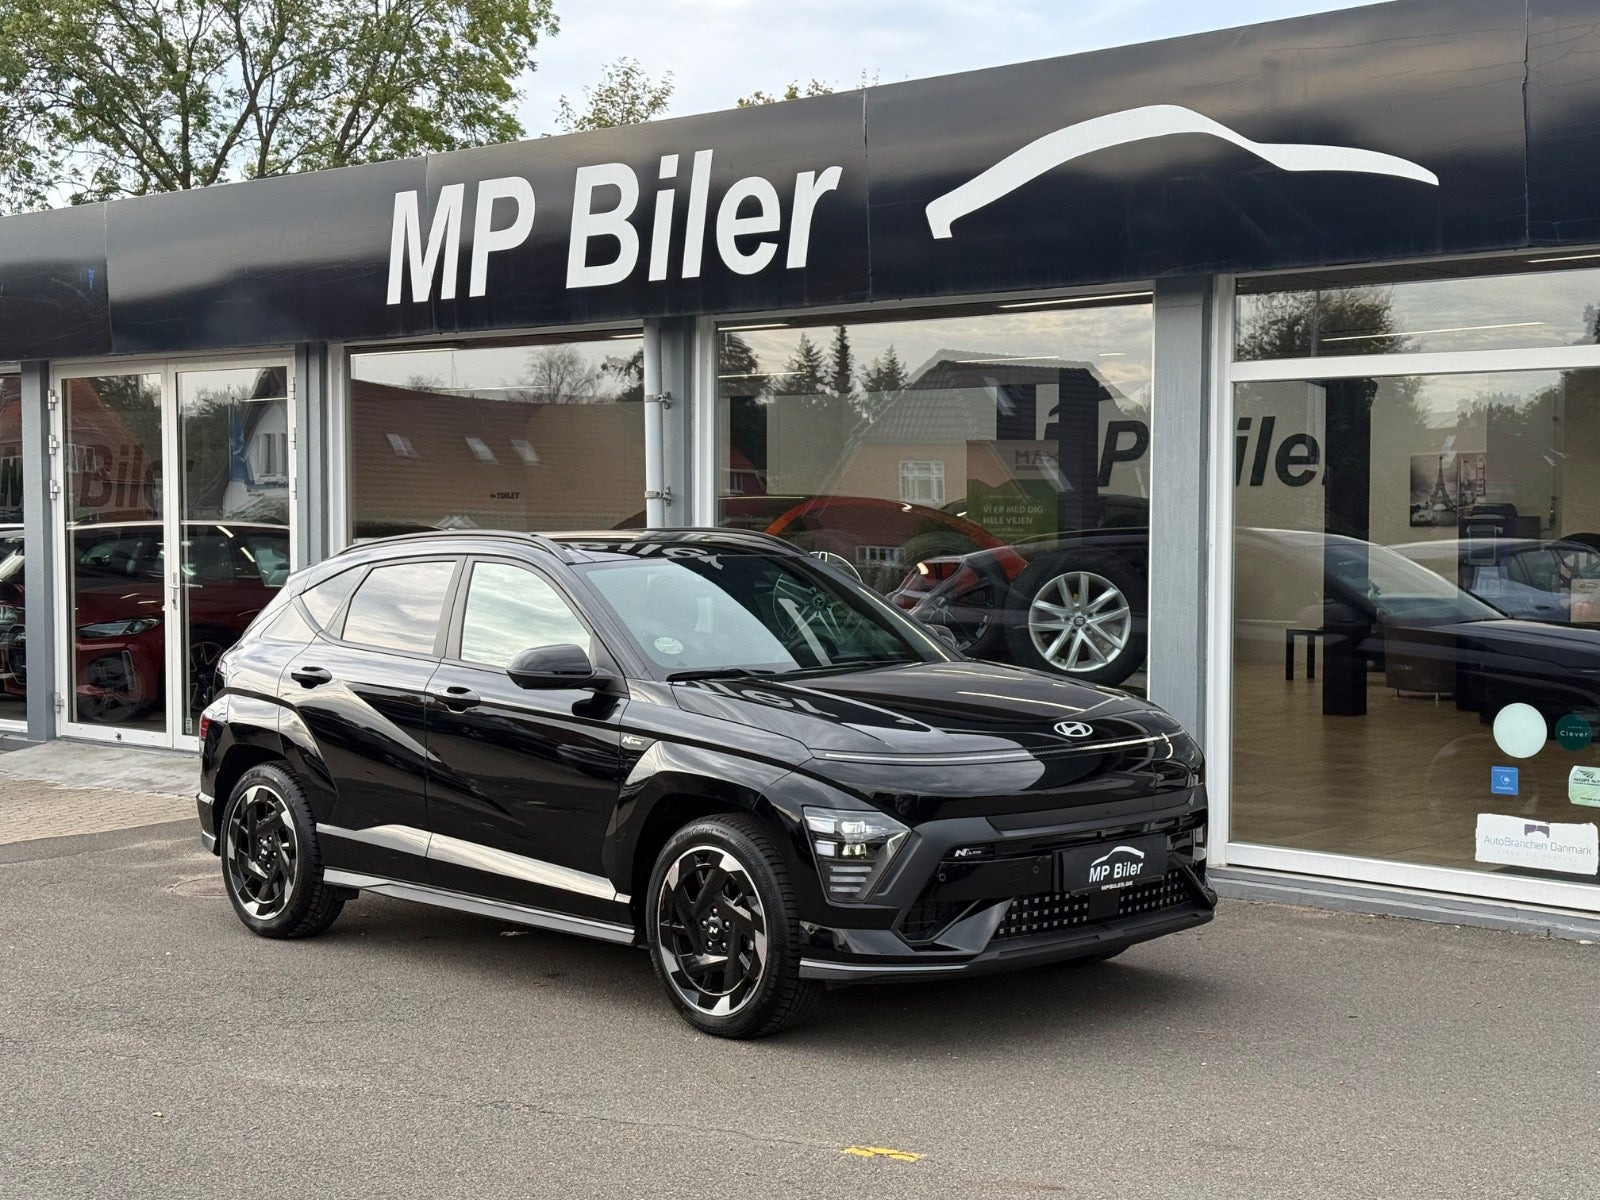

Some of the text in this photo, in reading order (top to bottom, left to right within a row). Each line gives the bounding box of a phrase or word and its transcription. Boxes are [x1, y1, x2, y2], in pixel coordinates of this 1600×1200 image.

[387, 148, 843, 305] MP Biler
[1235, 416, 1325, 487] ile
[1027, 505, 1043, 513] DIG
[1560, 730, 1588, 738] Clever
[1483, 835, 1592, 856] AutoBranchen Danmark
[1089, 860, 1143, 883] MP Biler
